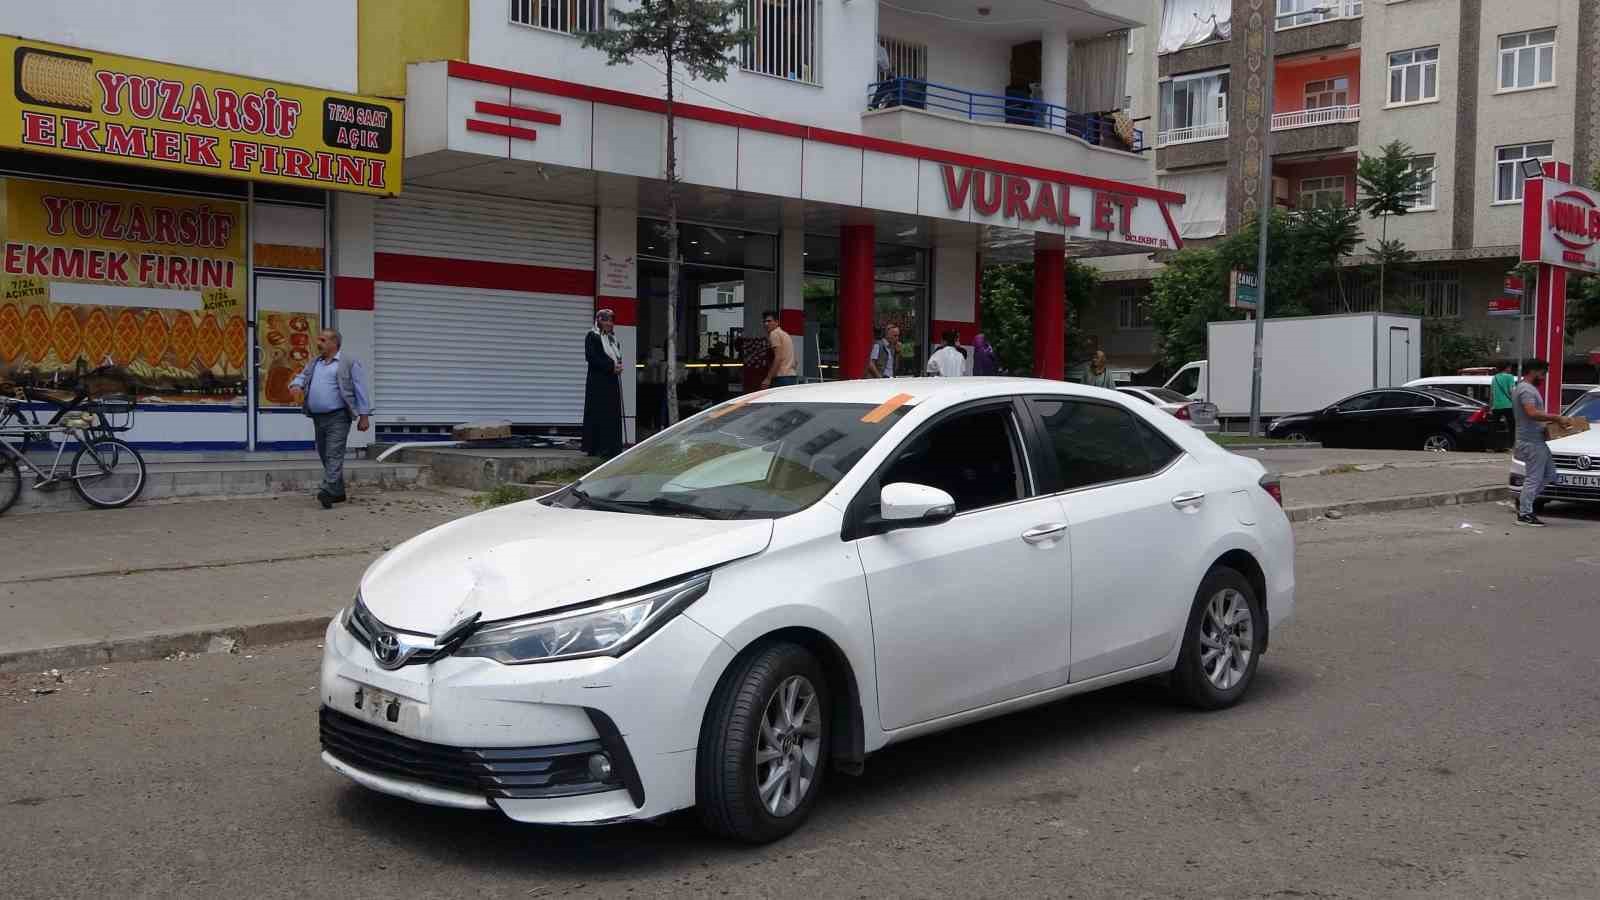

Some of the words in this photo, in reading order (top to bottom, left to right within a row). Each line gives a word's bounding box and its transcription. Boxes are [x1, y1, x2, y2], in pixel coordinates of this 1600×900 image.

[96, 70, 301, 138] YUZARSİF
[356, 108, 388, 129] SAAT
[23, 112, 220, 167] EKMEK
[231, 140, 386, 188] FIRINI
[336, 127, 379, 149] AÇIK
[942, 164, 1080, 227] VURAL
[1092, 190, 1138, 234] ET
[41, 195, 235, 248] YUZARSİF
[4, 242, 129, 281] EKMEK
[139, 253, 236, 288] FIRINI
[6, 288, 45, 299] AÇIKTIR
[11, 279, 34, 289] 7/24
[209, 291, 228, 302] 7/24
